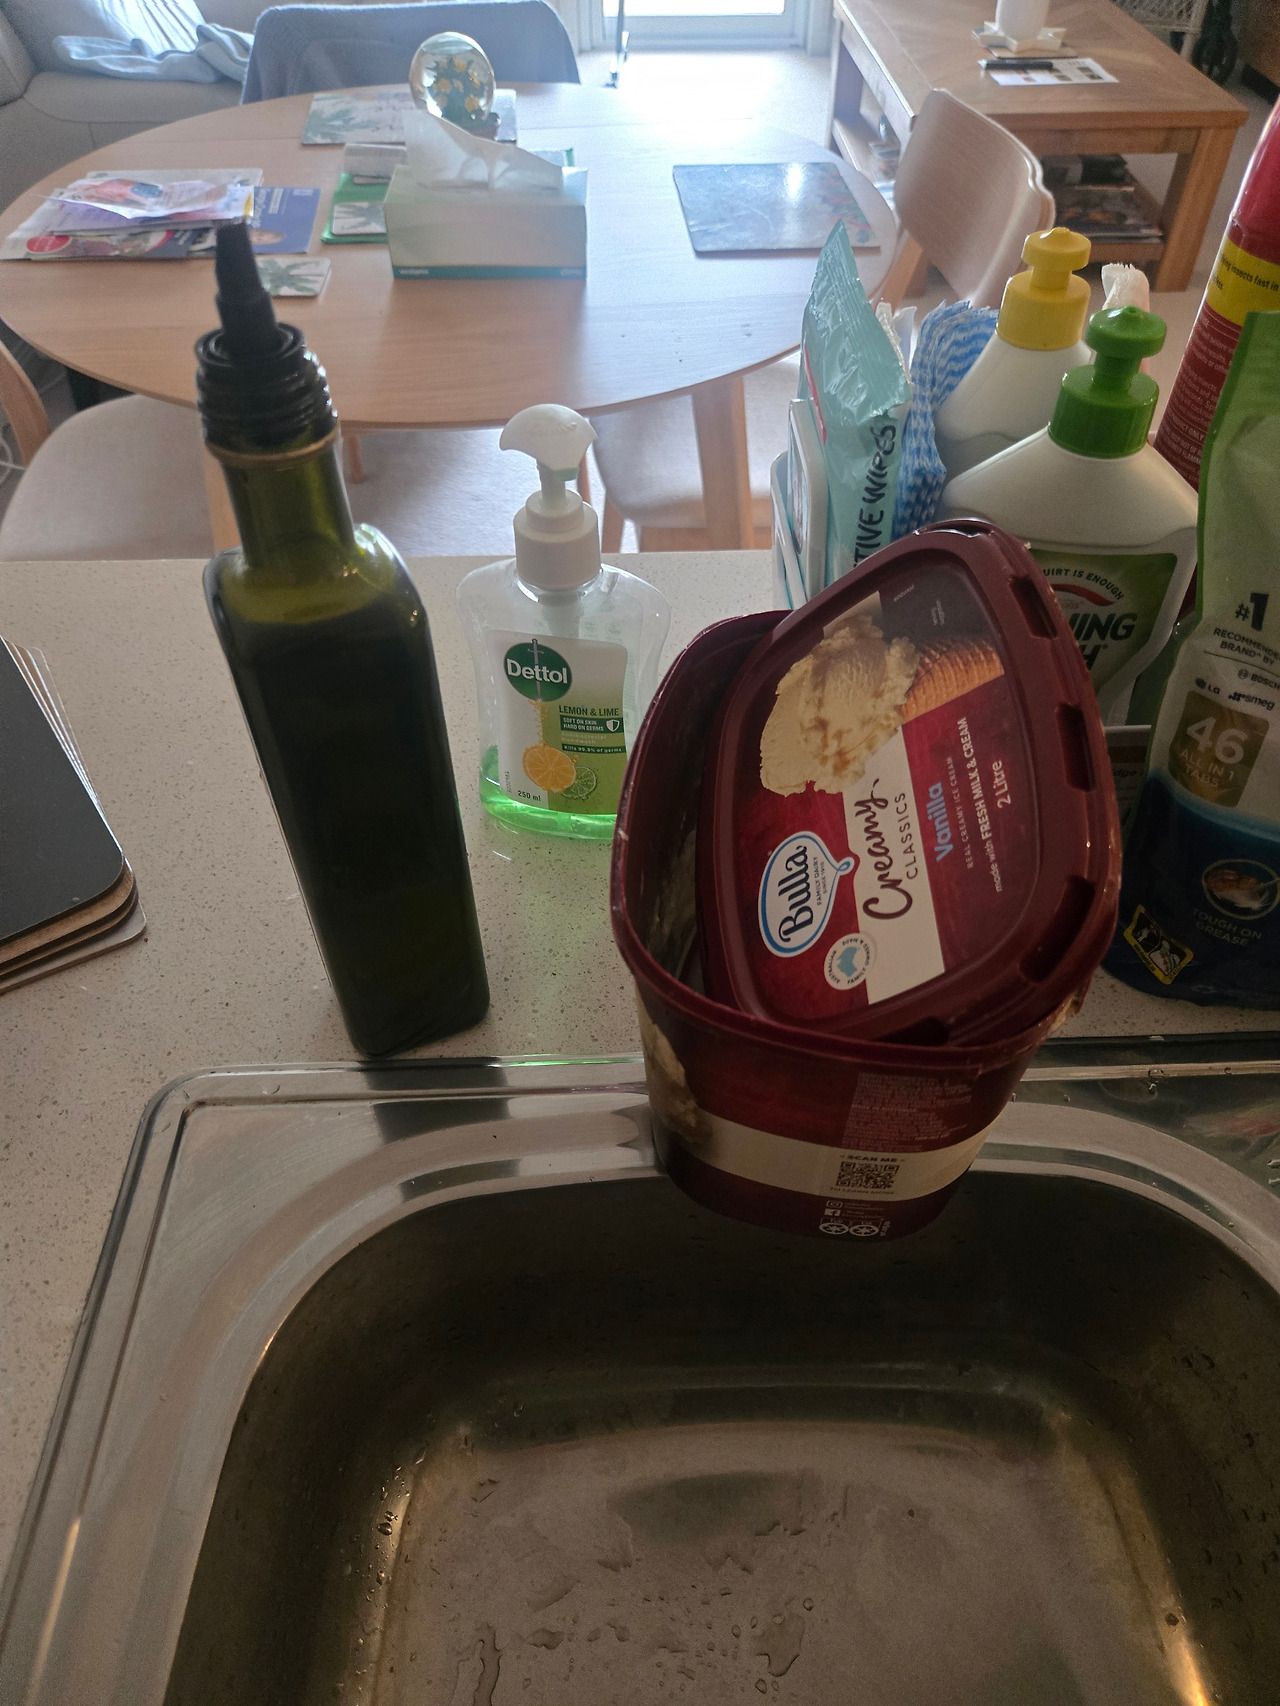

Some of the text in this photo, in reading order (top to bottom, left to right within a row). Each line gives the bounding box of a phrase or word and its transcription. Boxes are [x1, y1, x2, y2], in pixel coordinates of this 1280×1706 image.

[1231, 264, 1254, 282] insects
[1254, 275, 1269, 290] fast
[1270, 283, 1280, 292] in
[854, 426, 896, 567] TIVE WIPES
[1043, 568, 1124, 600] UIRT IS ENOUGH
[1235, 592, 1269, 632] #1
[1213, 627, 1280, 662] RECOMMENDE
[1263, 654, 1275, 667] BY
[507, 658, 568, 684] Dettol
[1251, 673, 1280, 691] BOSCH
[1208, 684, 1220, 694] LG
[1245, 694, 1275, 711] smeg
[559, 705, 588, 716] LEMON
[599, 708, 619, 717] LIME
[1186, 716, 1245, 764] 46
[992, 759, 1012, 809] 2 Litre
[1184, 762, 1220, 788] TABS
[1208, 761, 1226, 777] IN
[517, 790, 531, 799] 250
[957, 717, 1003, 893] made with FRESH MILK & CREAM
[926, 782, 953, 862] Vanilla
[945, 756, 975, 869] REAL CREAMY ICE CREAM
[854, 779, 913, 920] Creamy
[895, 793, 918, 880] CLASSICS
[778, 845, 814, 942] Bulla
[1193, 908, 1263, 940] TOUGH ON
[1195, 921, 1249, 947] GREASE
[828, 950, 840, 984] AUSTRALIAN
[847, 967, 866, 984] FAMILY
[847, 1154, 877, 1162] SCAN
